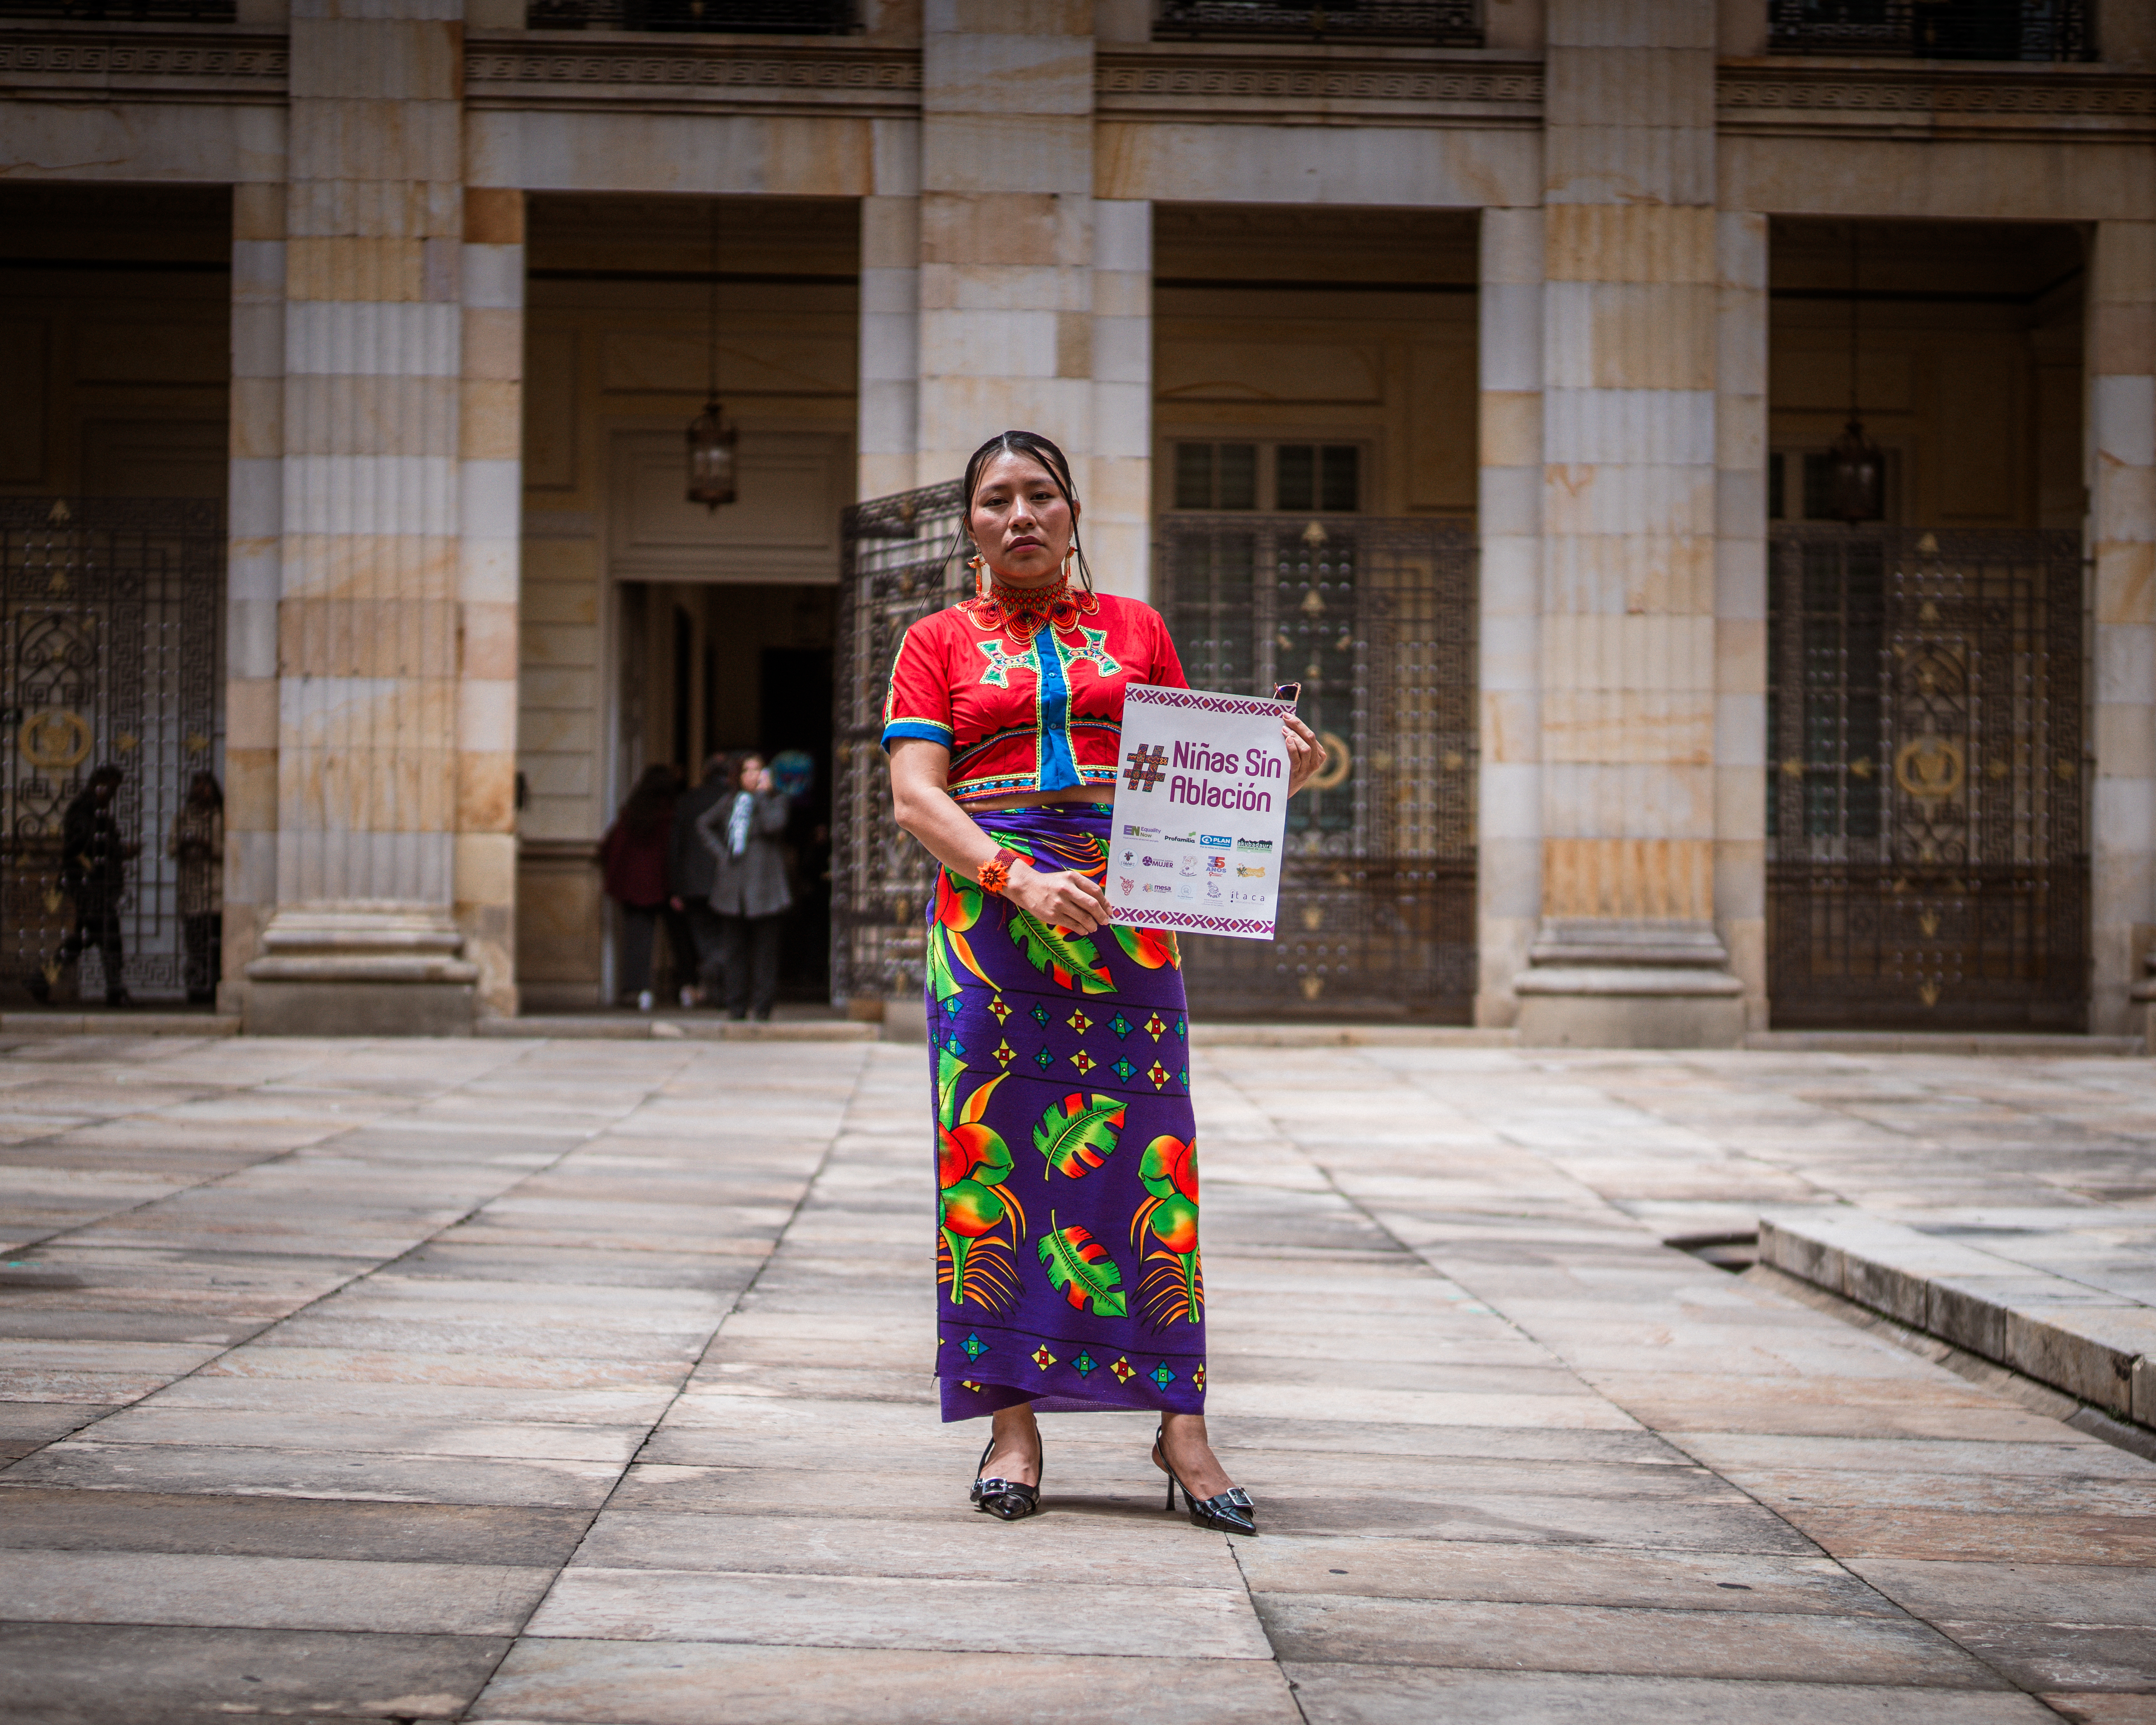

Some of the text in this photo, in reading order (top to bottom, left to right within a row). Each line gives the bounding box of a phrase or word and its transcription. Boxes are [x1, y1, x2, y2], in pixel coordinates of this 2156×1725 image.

[1172, 740, 1282, 778] Niñas Sin
[1169, 775, 1271, 812] Ablación
[1123, 825, 1140, 836] EN
[1238, 841, 1272, 849] akubadaura
[1207, 856, 1225, 869] 35
